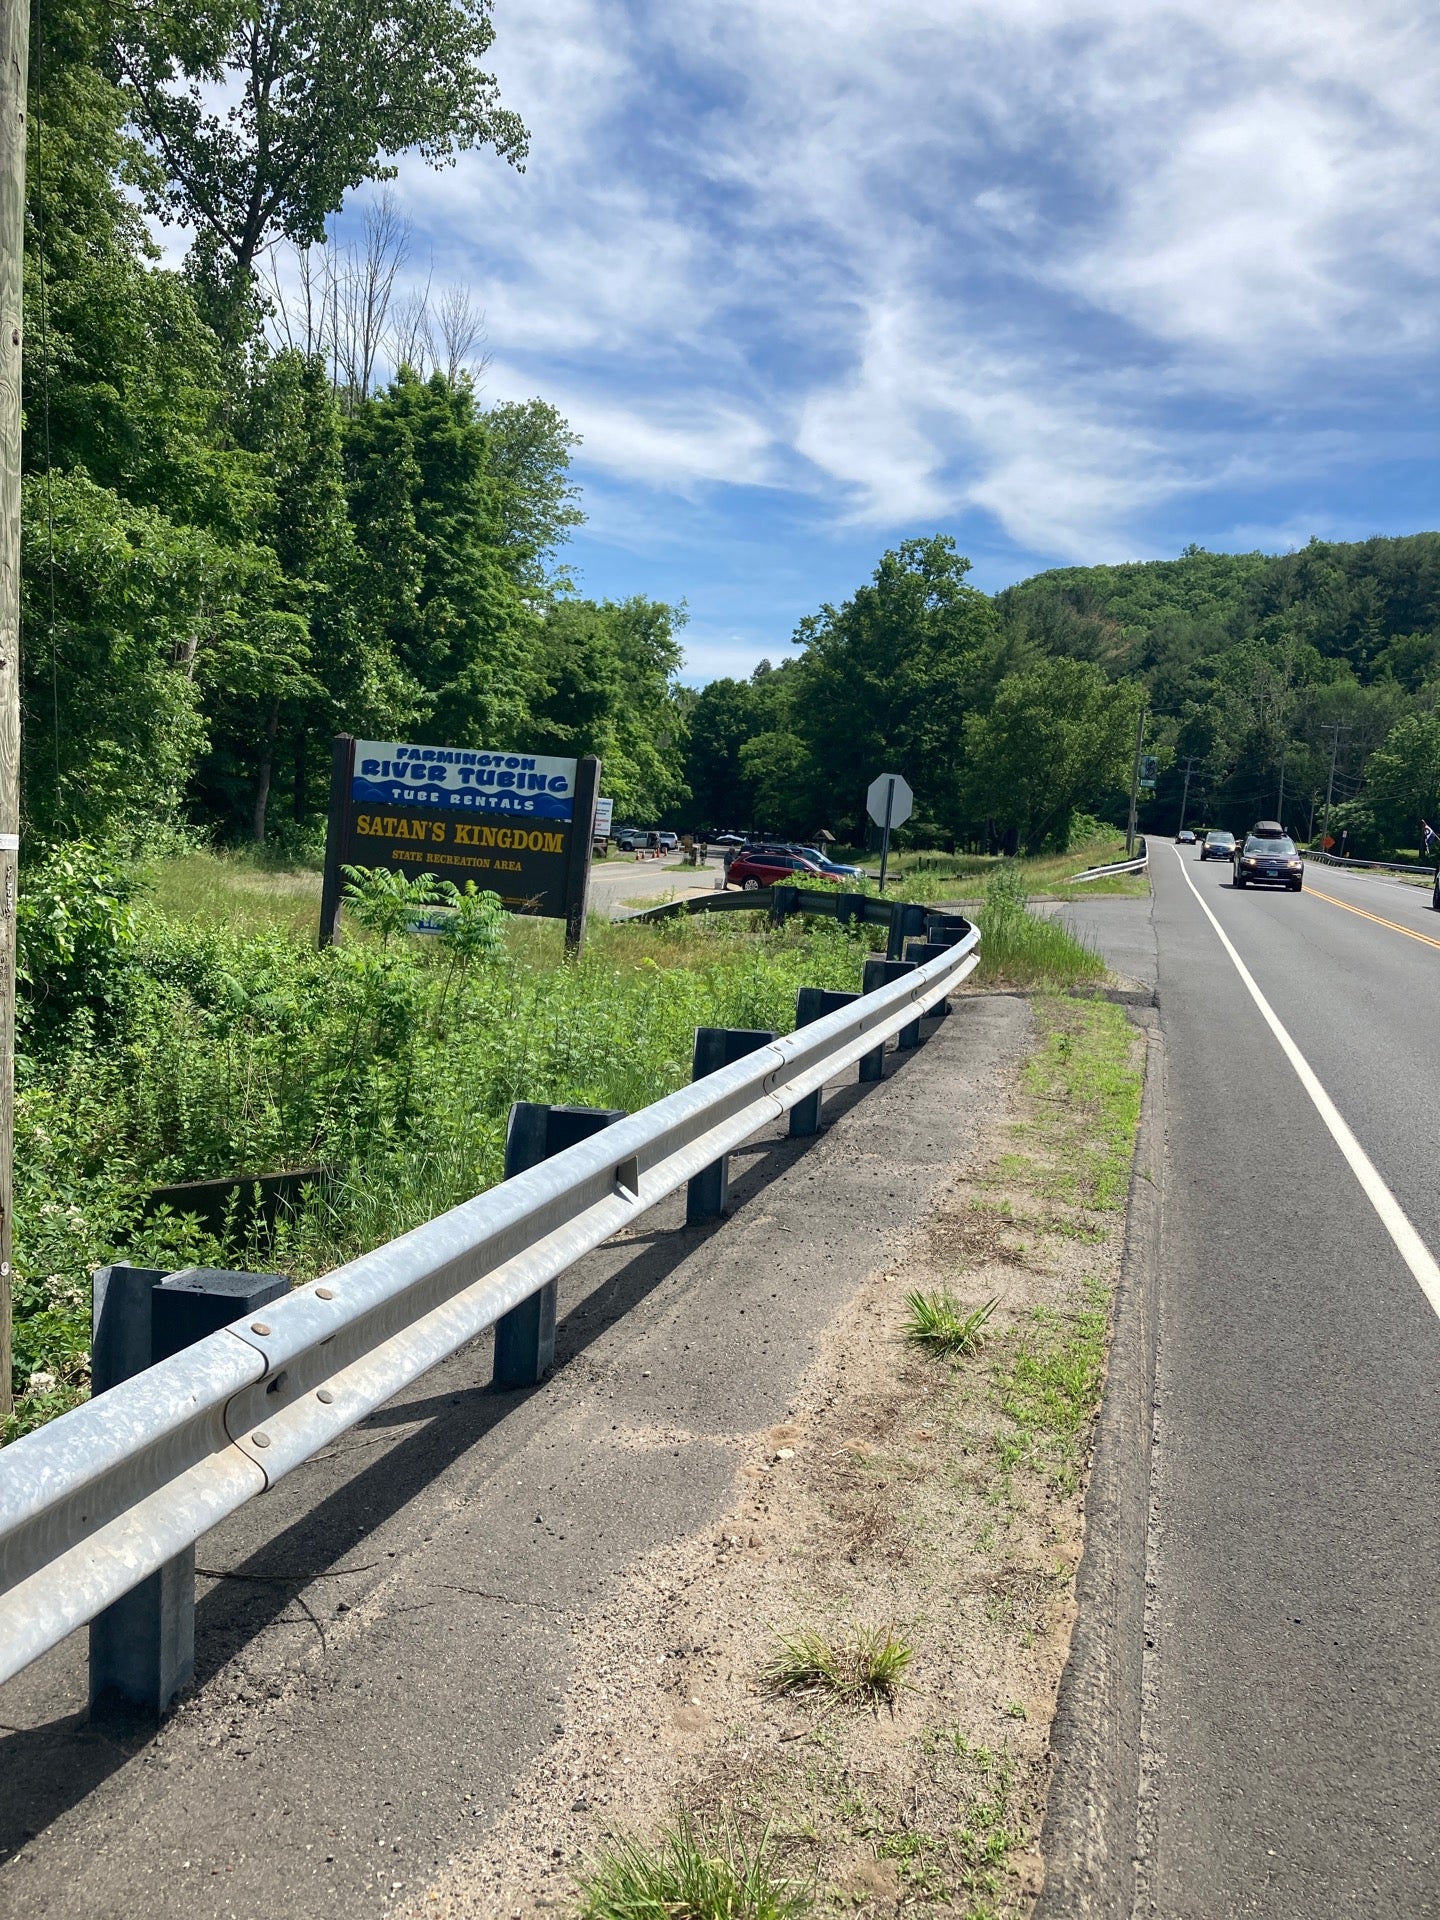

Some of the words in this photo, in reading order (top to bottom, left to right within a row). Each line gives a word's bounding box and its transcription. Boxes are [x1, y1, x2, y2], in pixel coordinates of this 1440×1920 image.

[396, 747, 536, 771] FARMINGTON
[361, 759, 447, 782] RIVER
[458, 767, 568, 792] TUBING
[392, 788, 439, 802] TUBE
[450, 794, 534, 811] RENTALS
[356, 814, 446, 842] SATAN'S
[454, 824, 564, 853] KINGDOM
[392, 850, 423, 862] STATE
[427, 853, 490, 868] RECREATION
[493, 859, 522, 871] AREA
